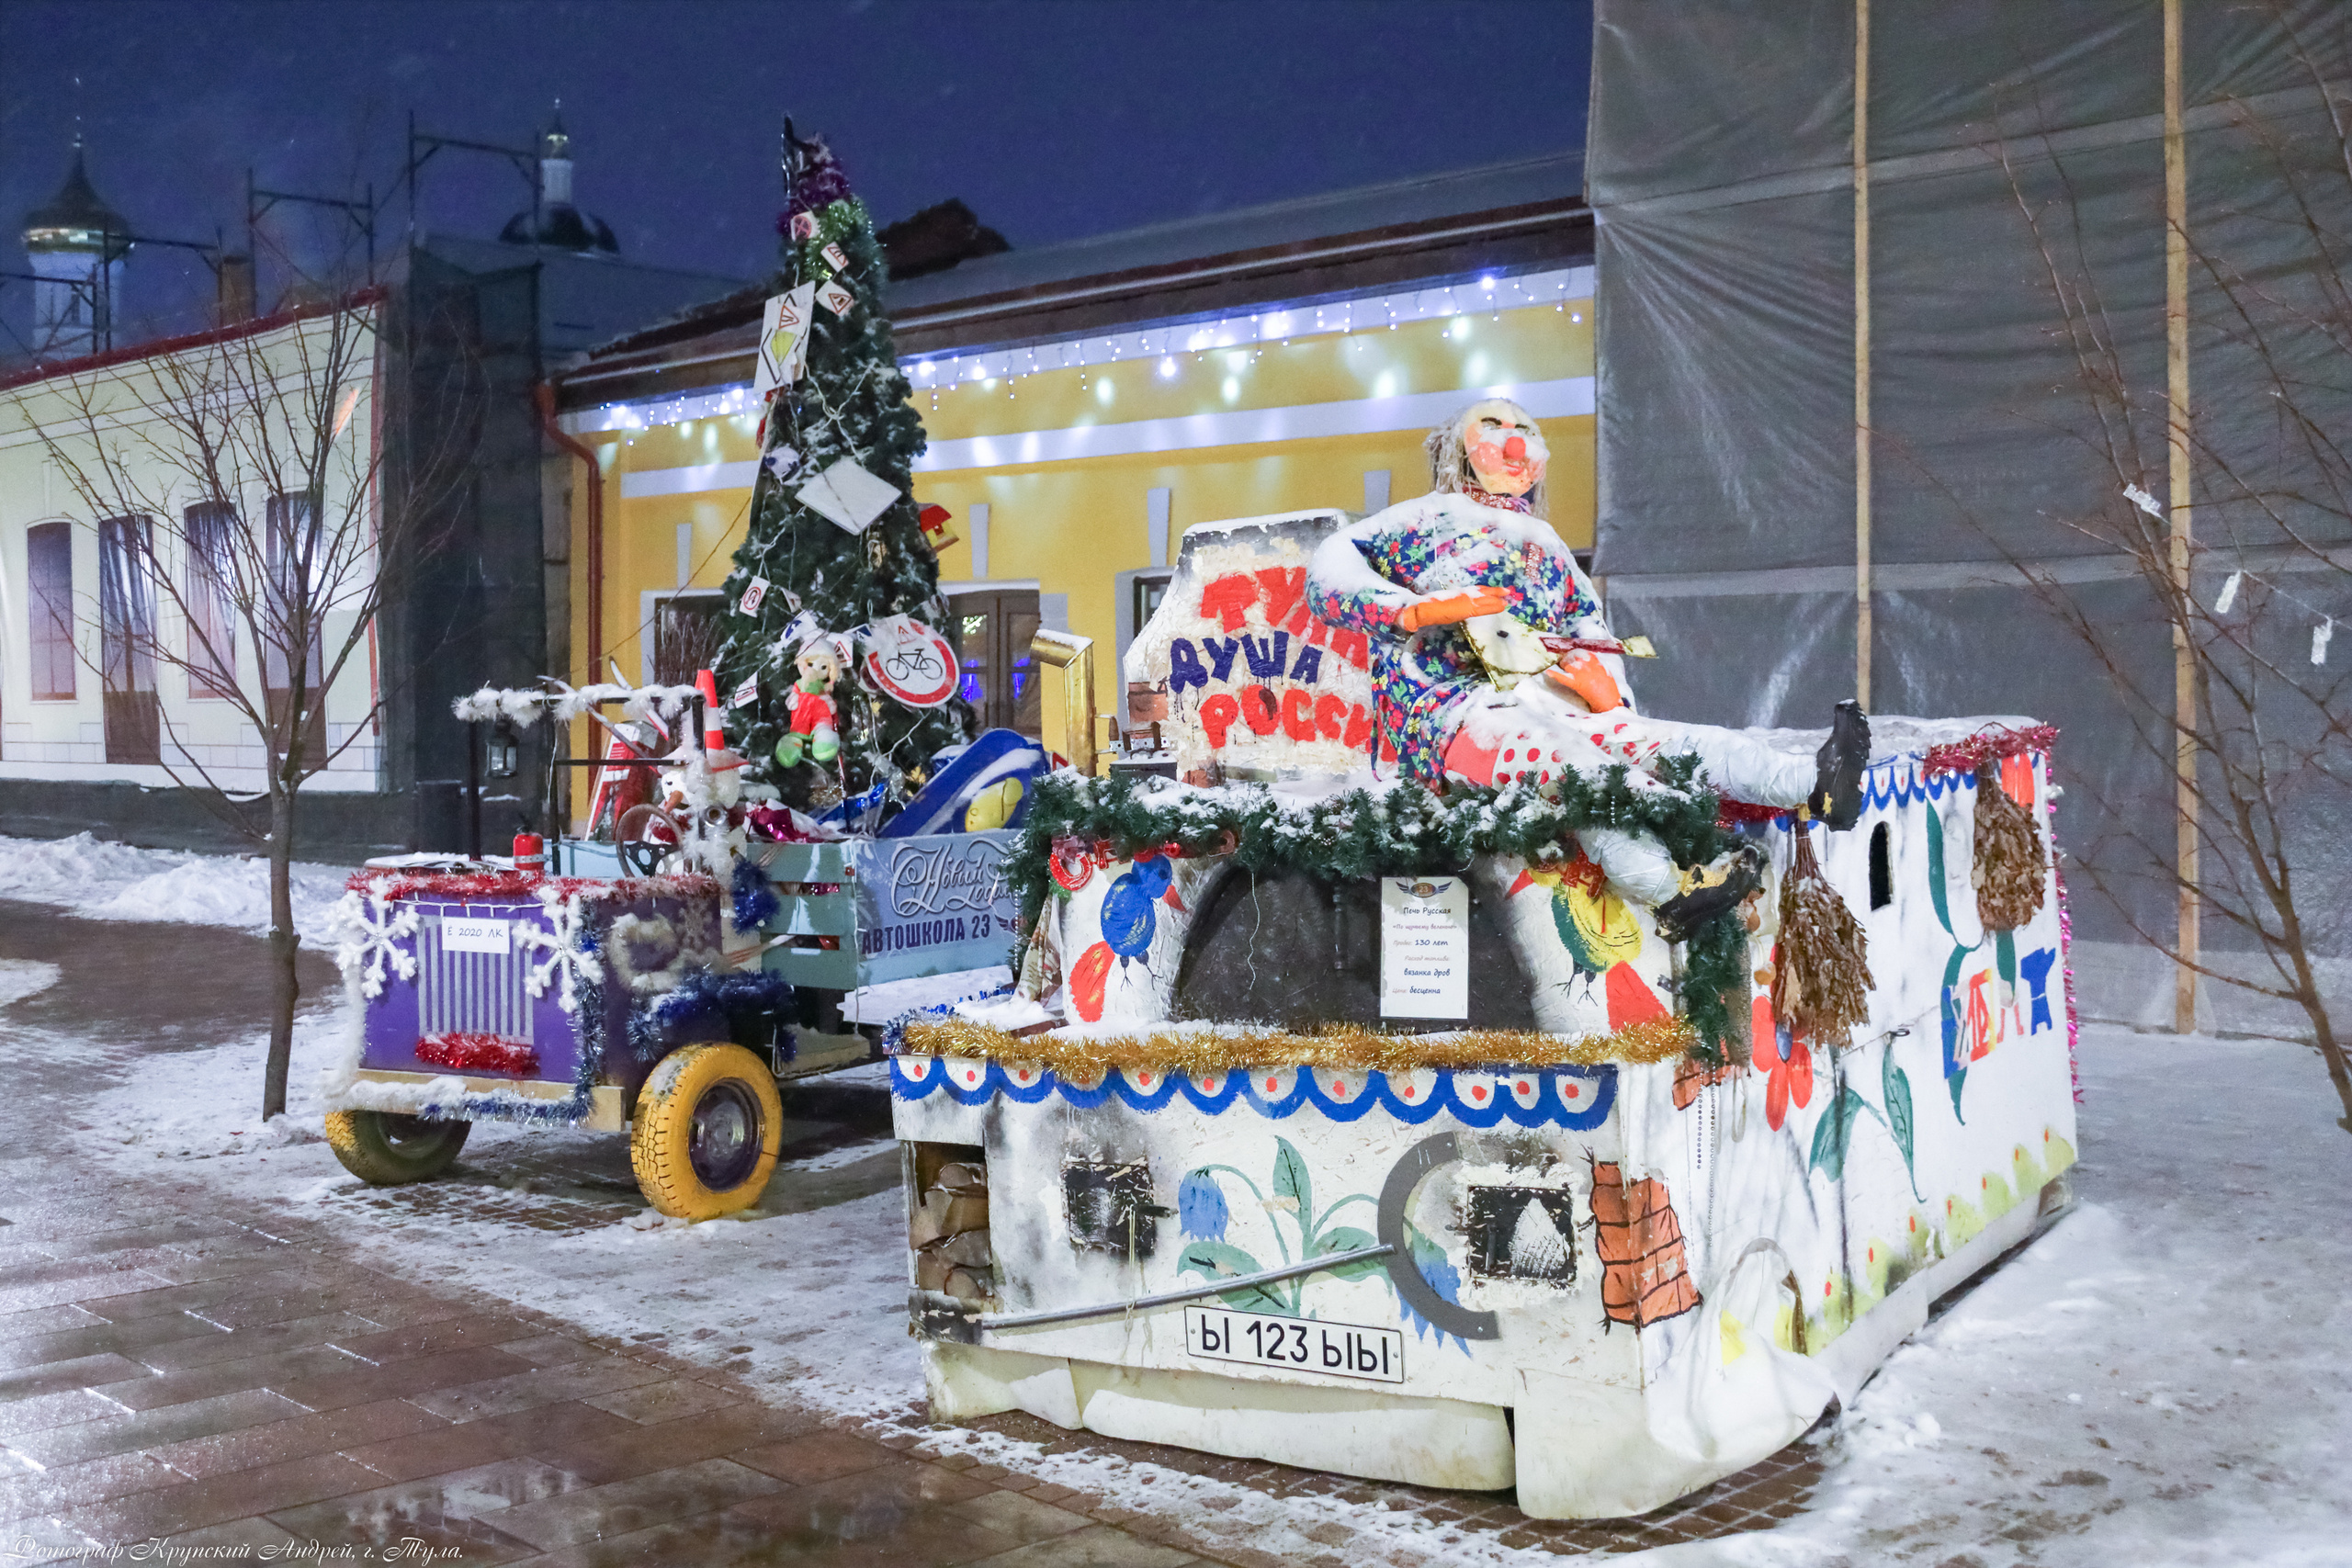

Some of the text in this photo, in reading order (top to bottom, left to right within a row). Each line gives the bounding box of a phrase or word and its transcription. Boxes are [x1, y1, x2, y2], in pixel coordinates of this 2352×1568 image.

[1169, 630, 1324, 694] ДУША
[1403, 907, 1452, 917] Печь Русская
[458, 927, 483, 937] 2020
[488, 928, 504, 938] ЛК
[862, 914, 990, 955] АВТОШКОЛА 23
[1403, 967, 1451, 978] вязанка дров
[1408, 985, 1442, 995] бесценна
[1201, 1314, 1389, 1375] Ы 123 ЫЫ
